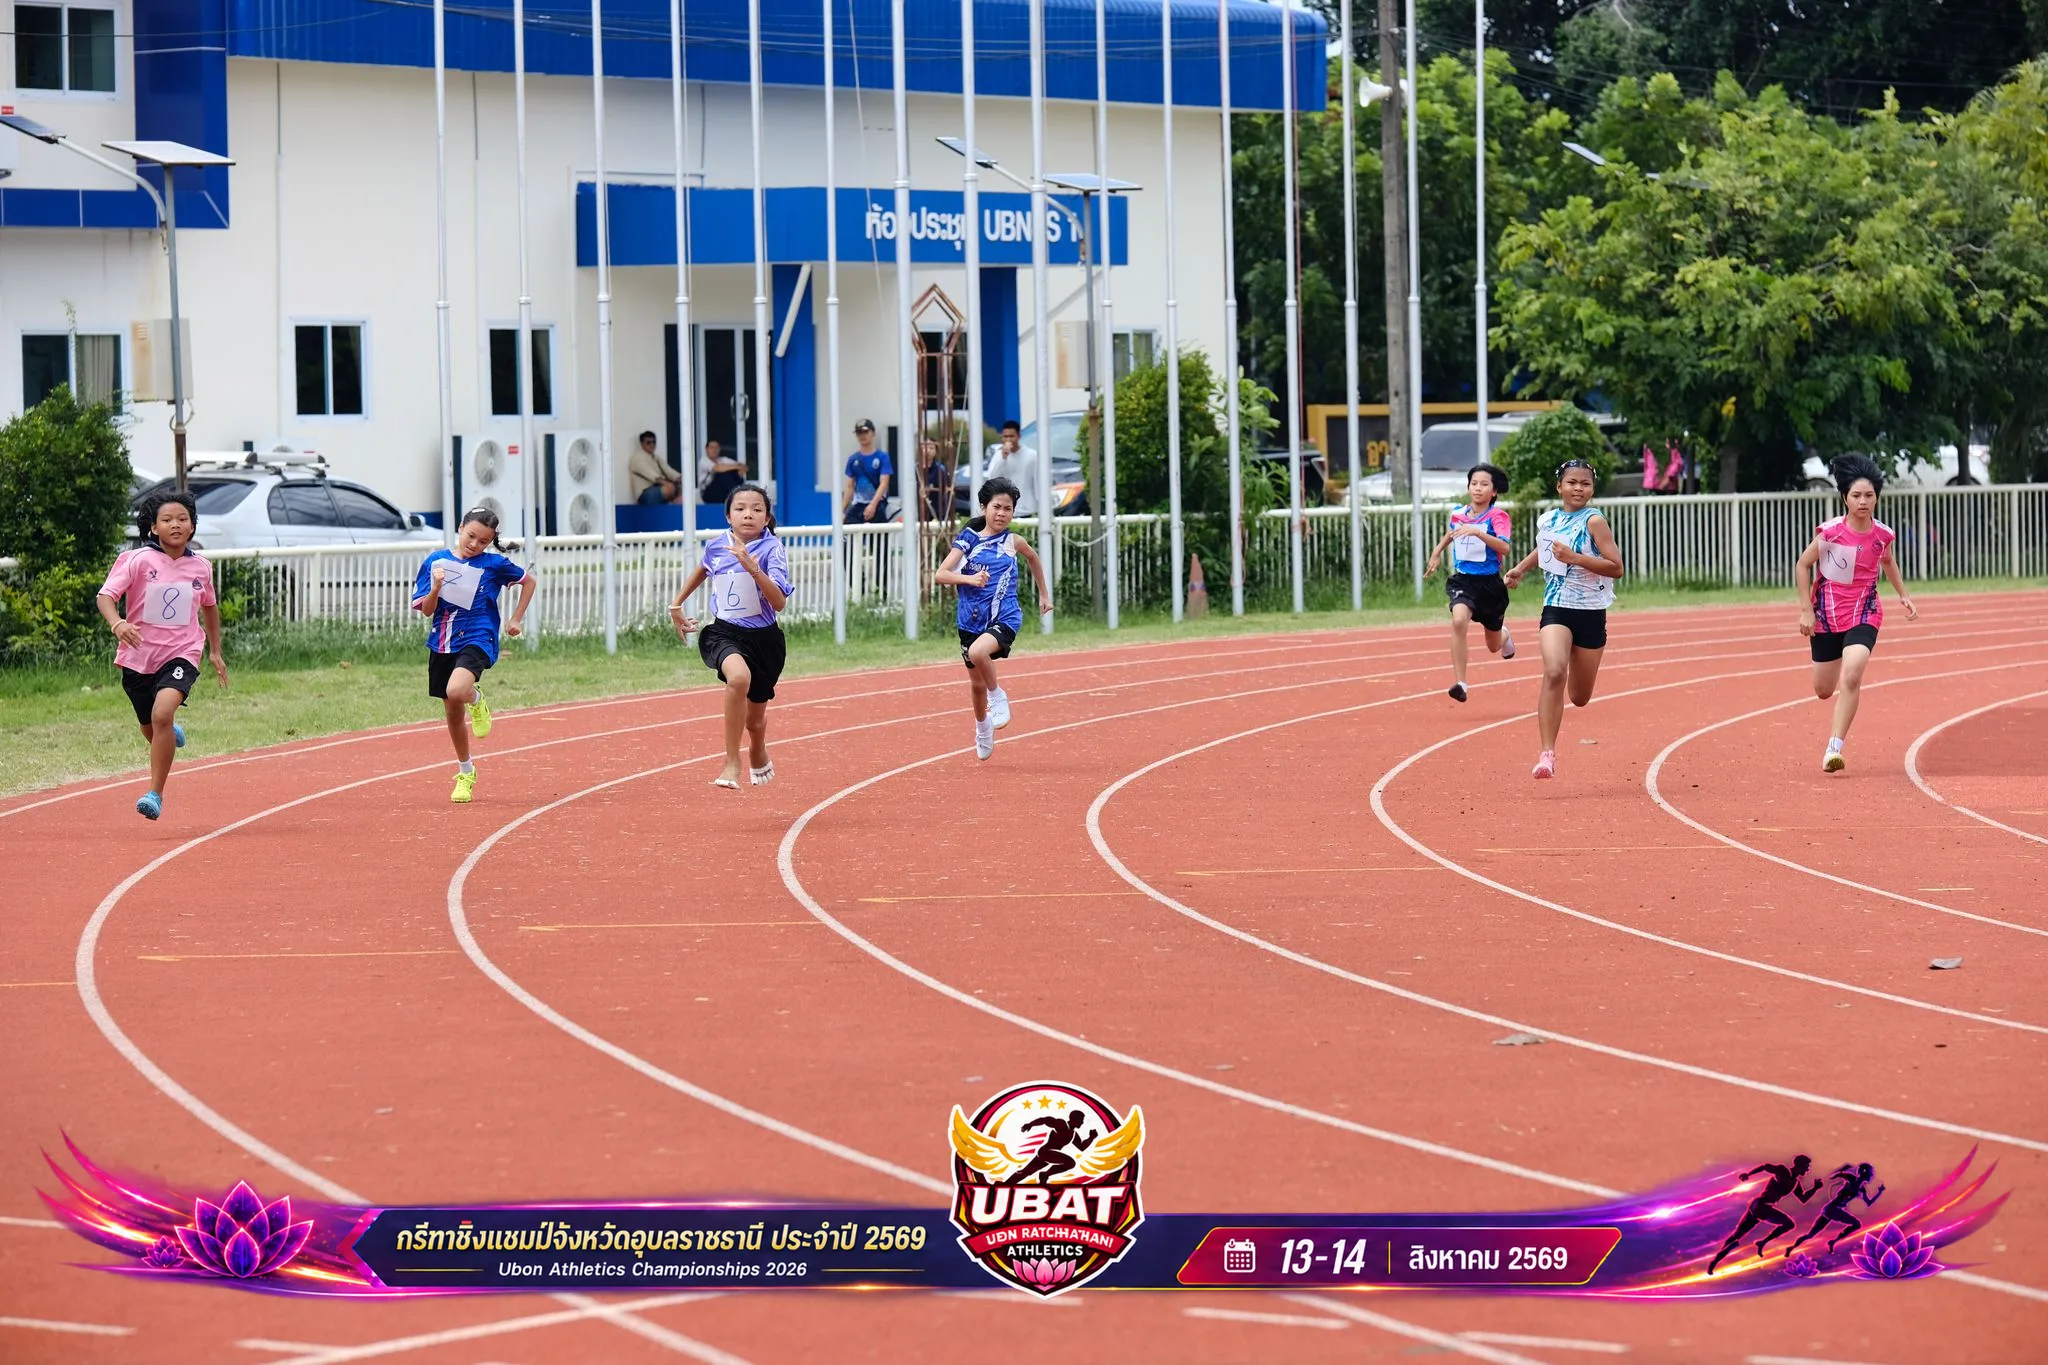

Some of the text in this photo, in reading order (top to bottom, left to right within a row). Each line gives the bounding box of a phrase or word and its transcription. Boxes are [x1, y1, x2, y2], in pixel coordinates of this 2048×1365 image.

[1542, 538, 1553, 563] 3
[1827, 550, 1847, 569] 2
[162, 587, 180, 620] 8
[726, 580, 742, 609] 6
[172, 666, 185, 680] 8
